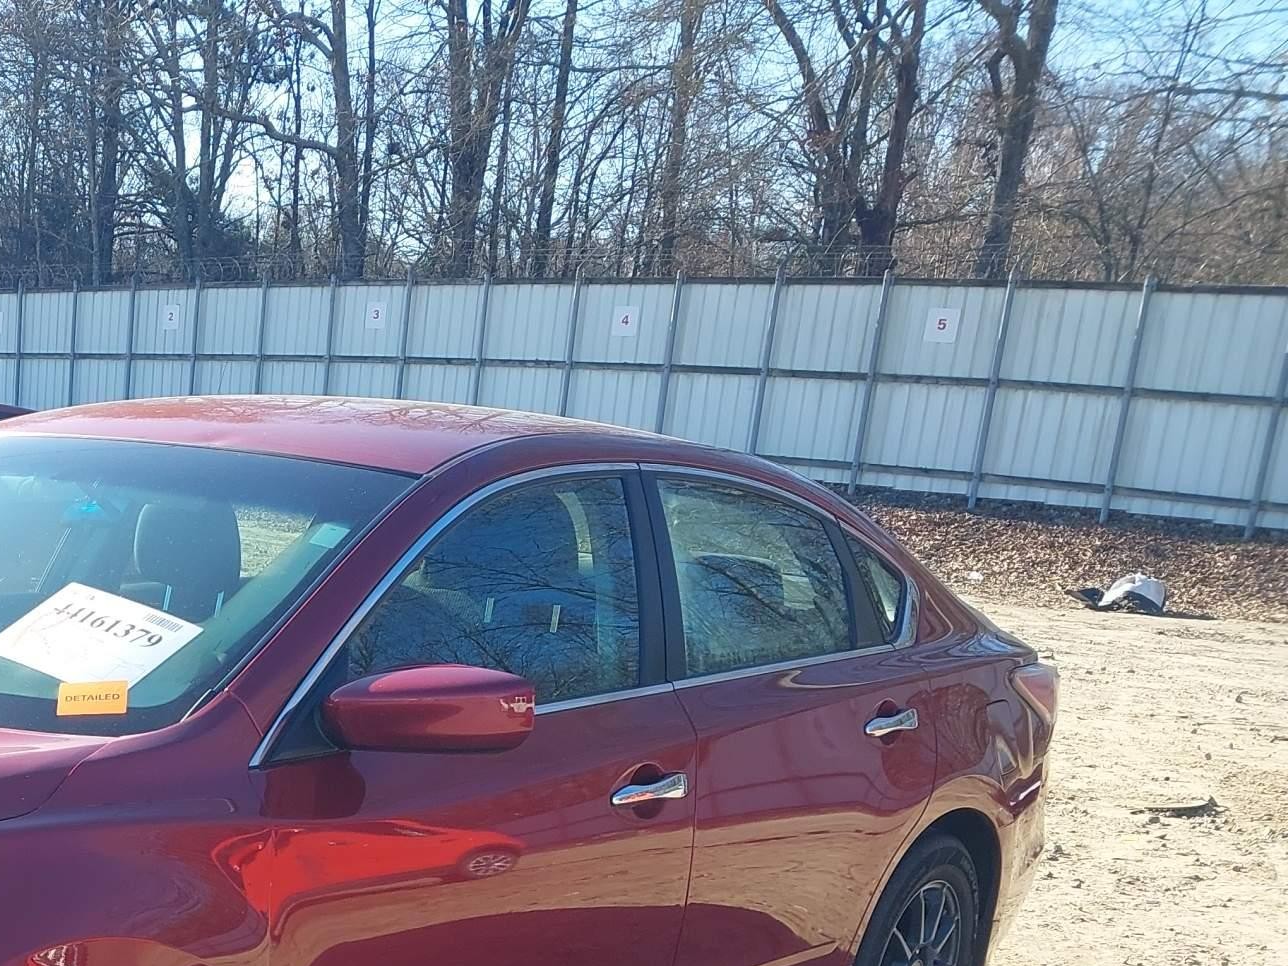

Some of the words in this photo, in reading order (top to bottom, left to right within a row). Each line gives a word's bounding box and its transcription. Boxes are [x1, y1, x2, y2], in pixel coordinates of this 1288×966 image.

[168, 312, 174, 321] 2
[373, 310, 380, 320] 3
[621, 315, 629, 325] 4
[937, 318, 947, 330] 5
[54, 602, 164, 647] 44161379
[64, 692, 120, 703] DETAILED
